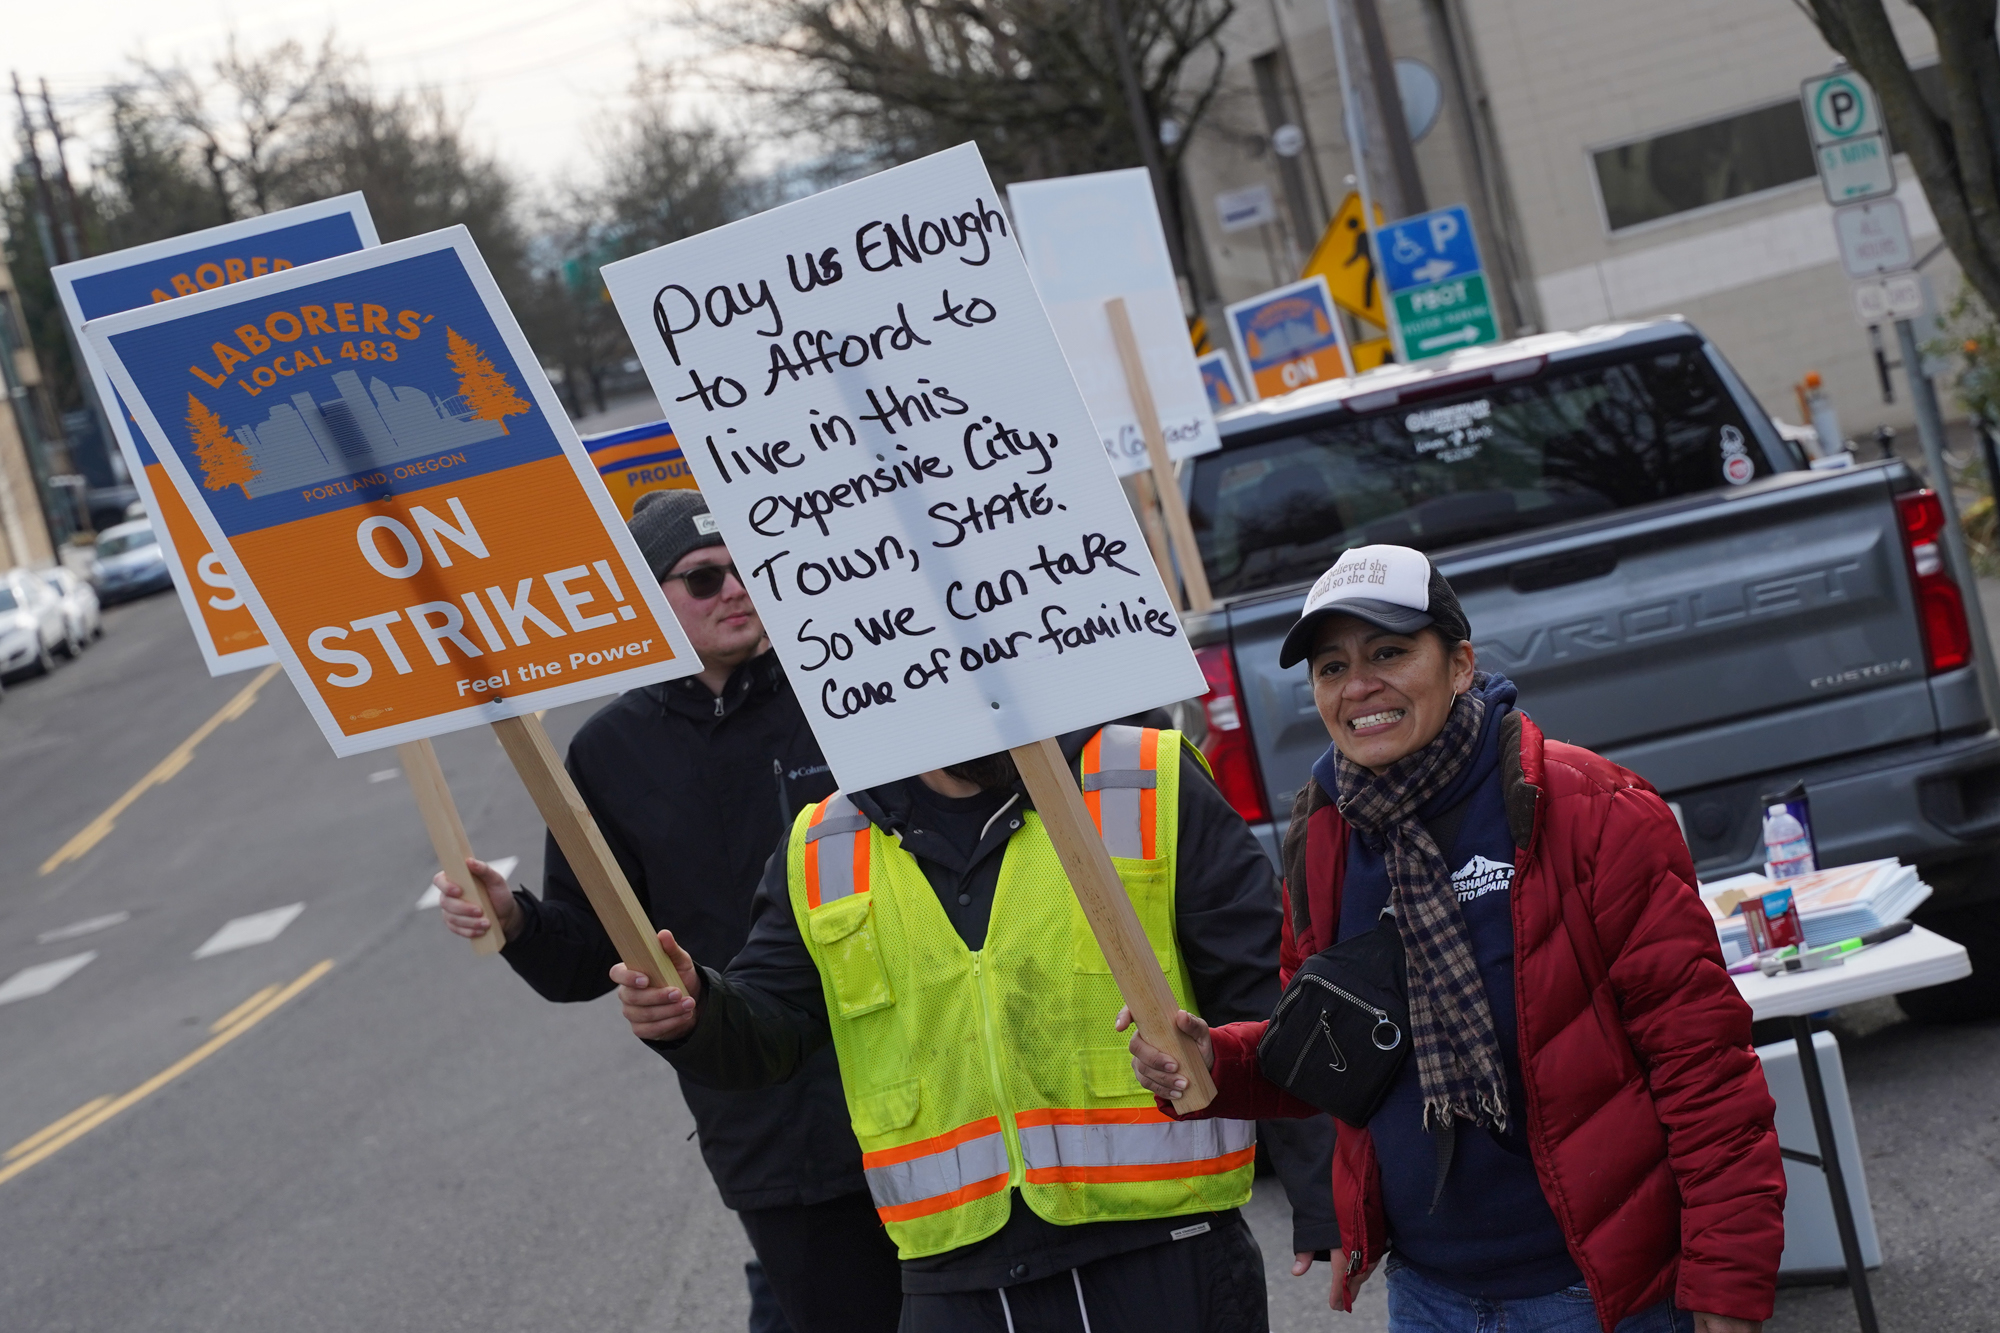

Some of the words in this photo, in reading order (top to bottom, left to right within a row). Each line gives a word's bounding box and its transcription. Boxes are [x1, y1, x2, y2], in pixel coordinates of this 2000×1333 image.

[1831, 91, 1853, 127] P
[1429, 214, 1459, 253] P
[189, 303, 435, 389] LABORERS'
[238, 346, 332, 397] LOCAL
[340, 340, 399, 362] 483
[675, 369, 748, 411] to
[764, 302, 932, 396] Afford
[932, 289, 997, 327] to
[1281, 356, 1318, 388] ON
[706, 427, 806, 484] live
[809, 409, 857, 451] in
[859, 378, 969, 434] this
[302, 472, 393, 502] PORTLAND,
[394, 452, 467, 480] OREGON
[749, 443, 954, 537] expensive
[356, 496, 491, 580] ON
[1369, 558, 1388, 572] she
[752, 535, 920, 601] Town,
[1332, 577, 1344, 589] so
[1346, 571, 1365, 585] she
[1367, 570, 1386, 585] did
[307, 558, 638, 688] STRIKE!
[797, 618, 854, 672] So
[456, 671, 511, 697] Feel
[517, 658, 562, 683] the
[568, 636, 654, 670] Power
[903, 647, 951, 690] of
[960, 631, 1033, 671] our
[797, 764, 830, 777] Colum
[1453, 874, 1488, 892] ESHAM
[1495, 869, 1505, 879] &
[1507, 868, 1515, 879] P
[1476, 880, 1510, 898] REPAIR
